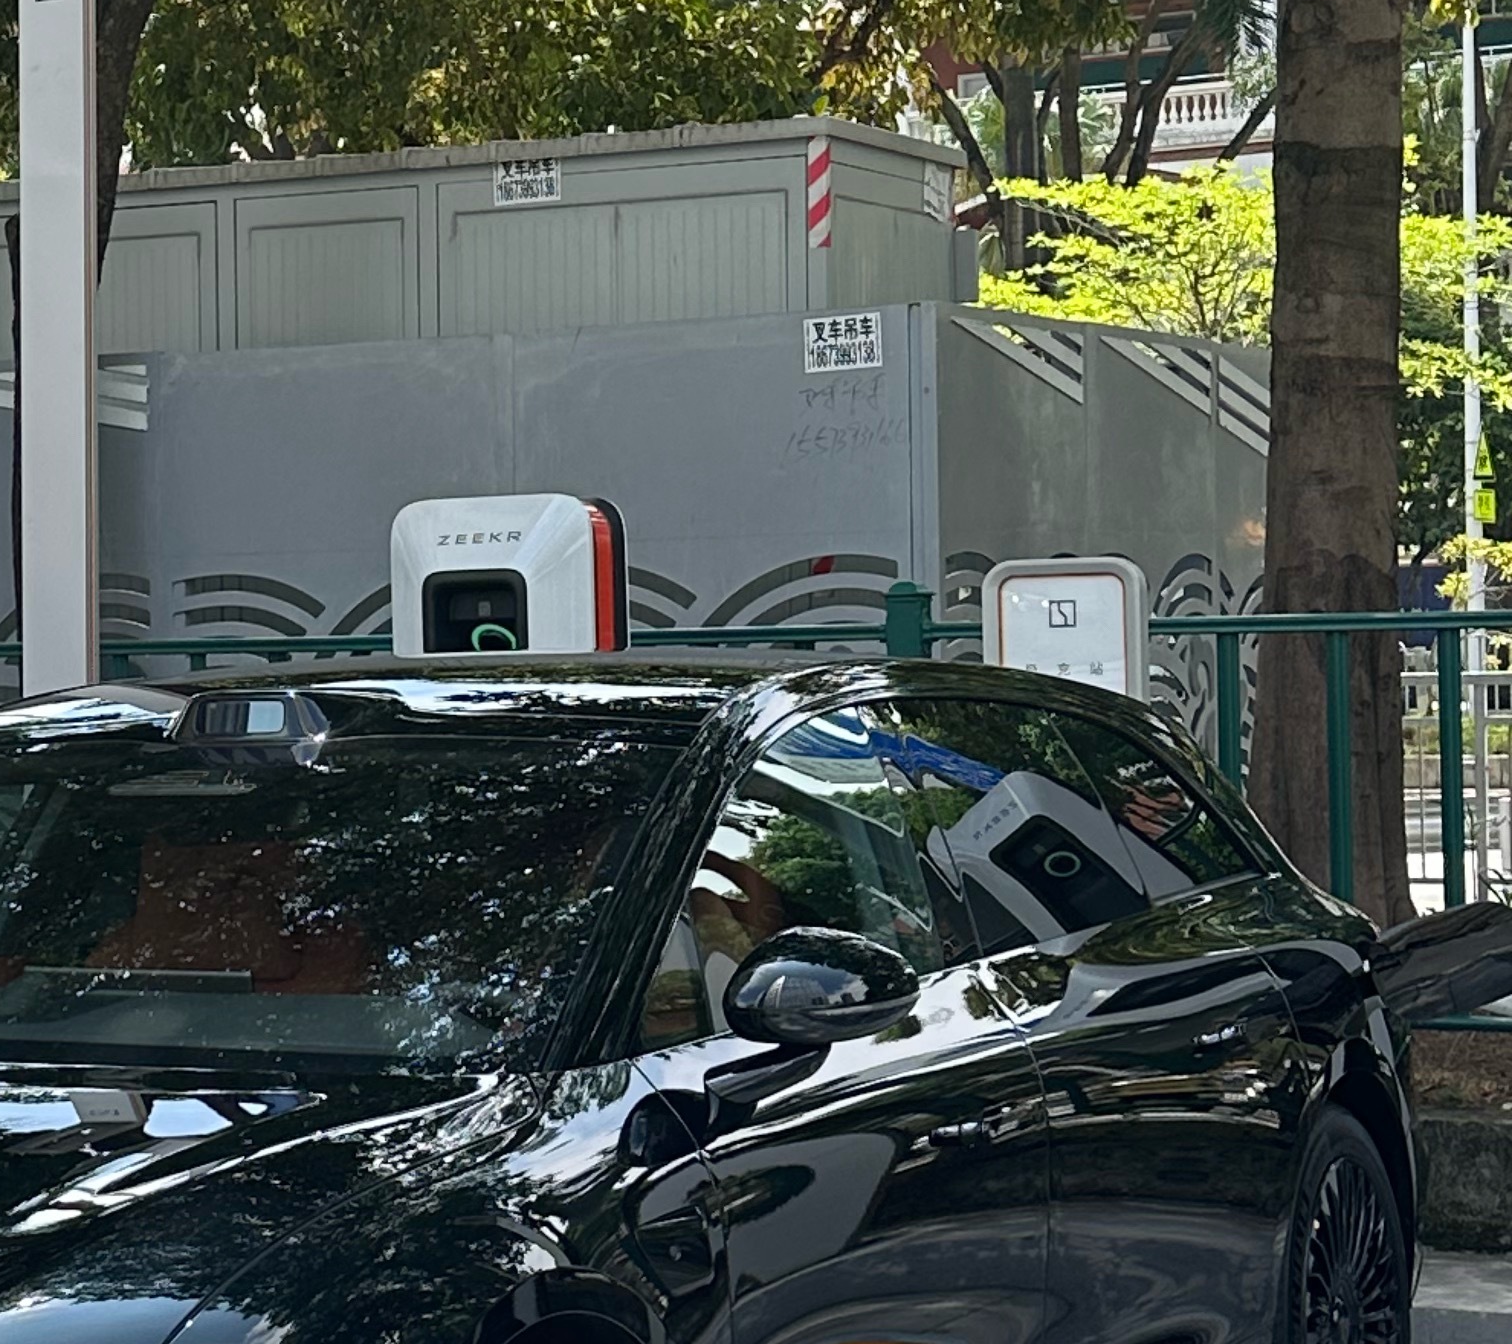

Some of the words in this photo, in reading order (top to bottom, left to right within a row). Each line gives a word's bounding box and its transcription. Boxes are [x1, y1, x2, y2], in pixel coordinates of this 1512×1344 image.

[812, 316, 875, 344] 叉车吊车
[437, 530, 522, 547] ZEEKR
